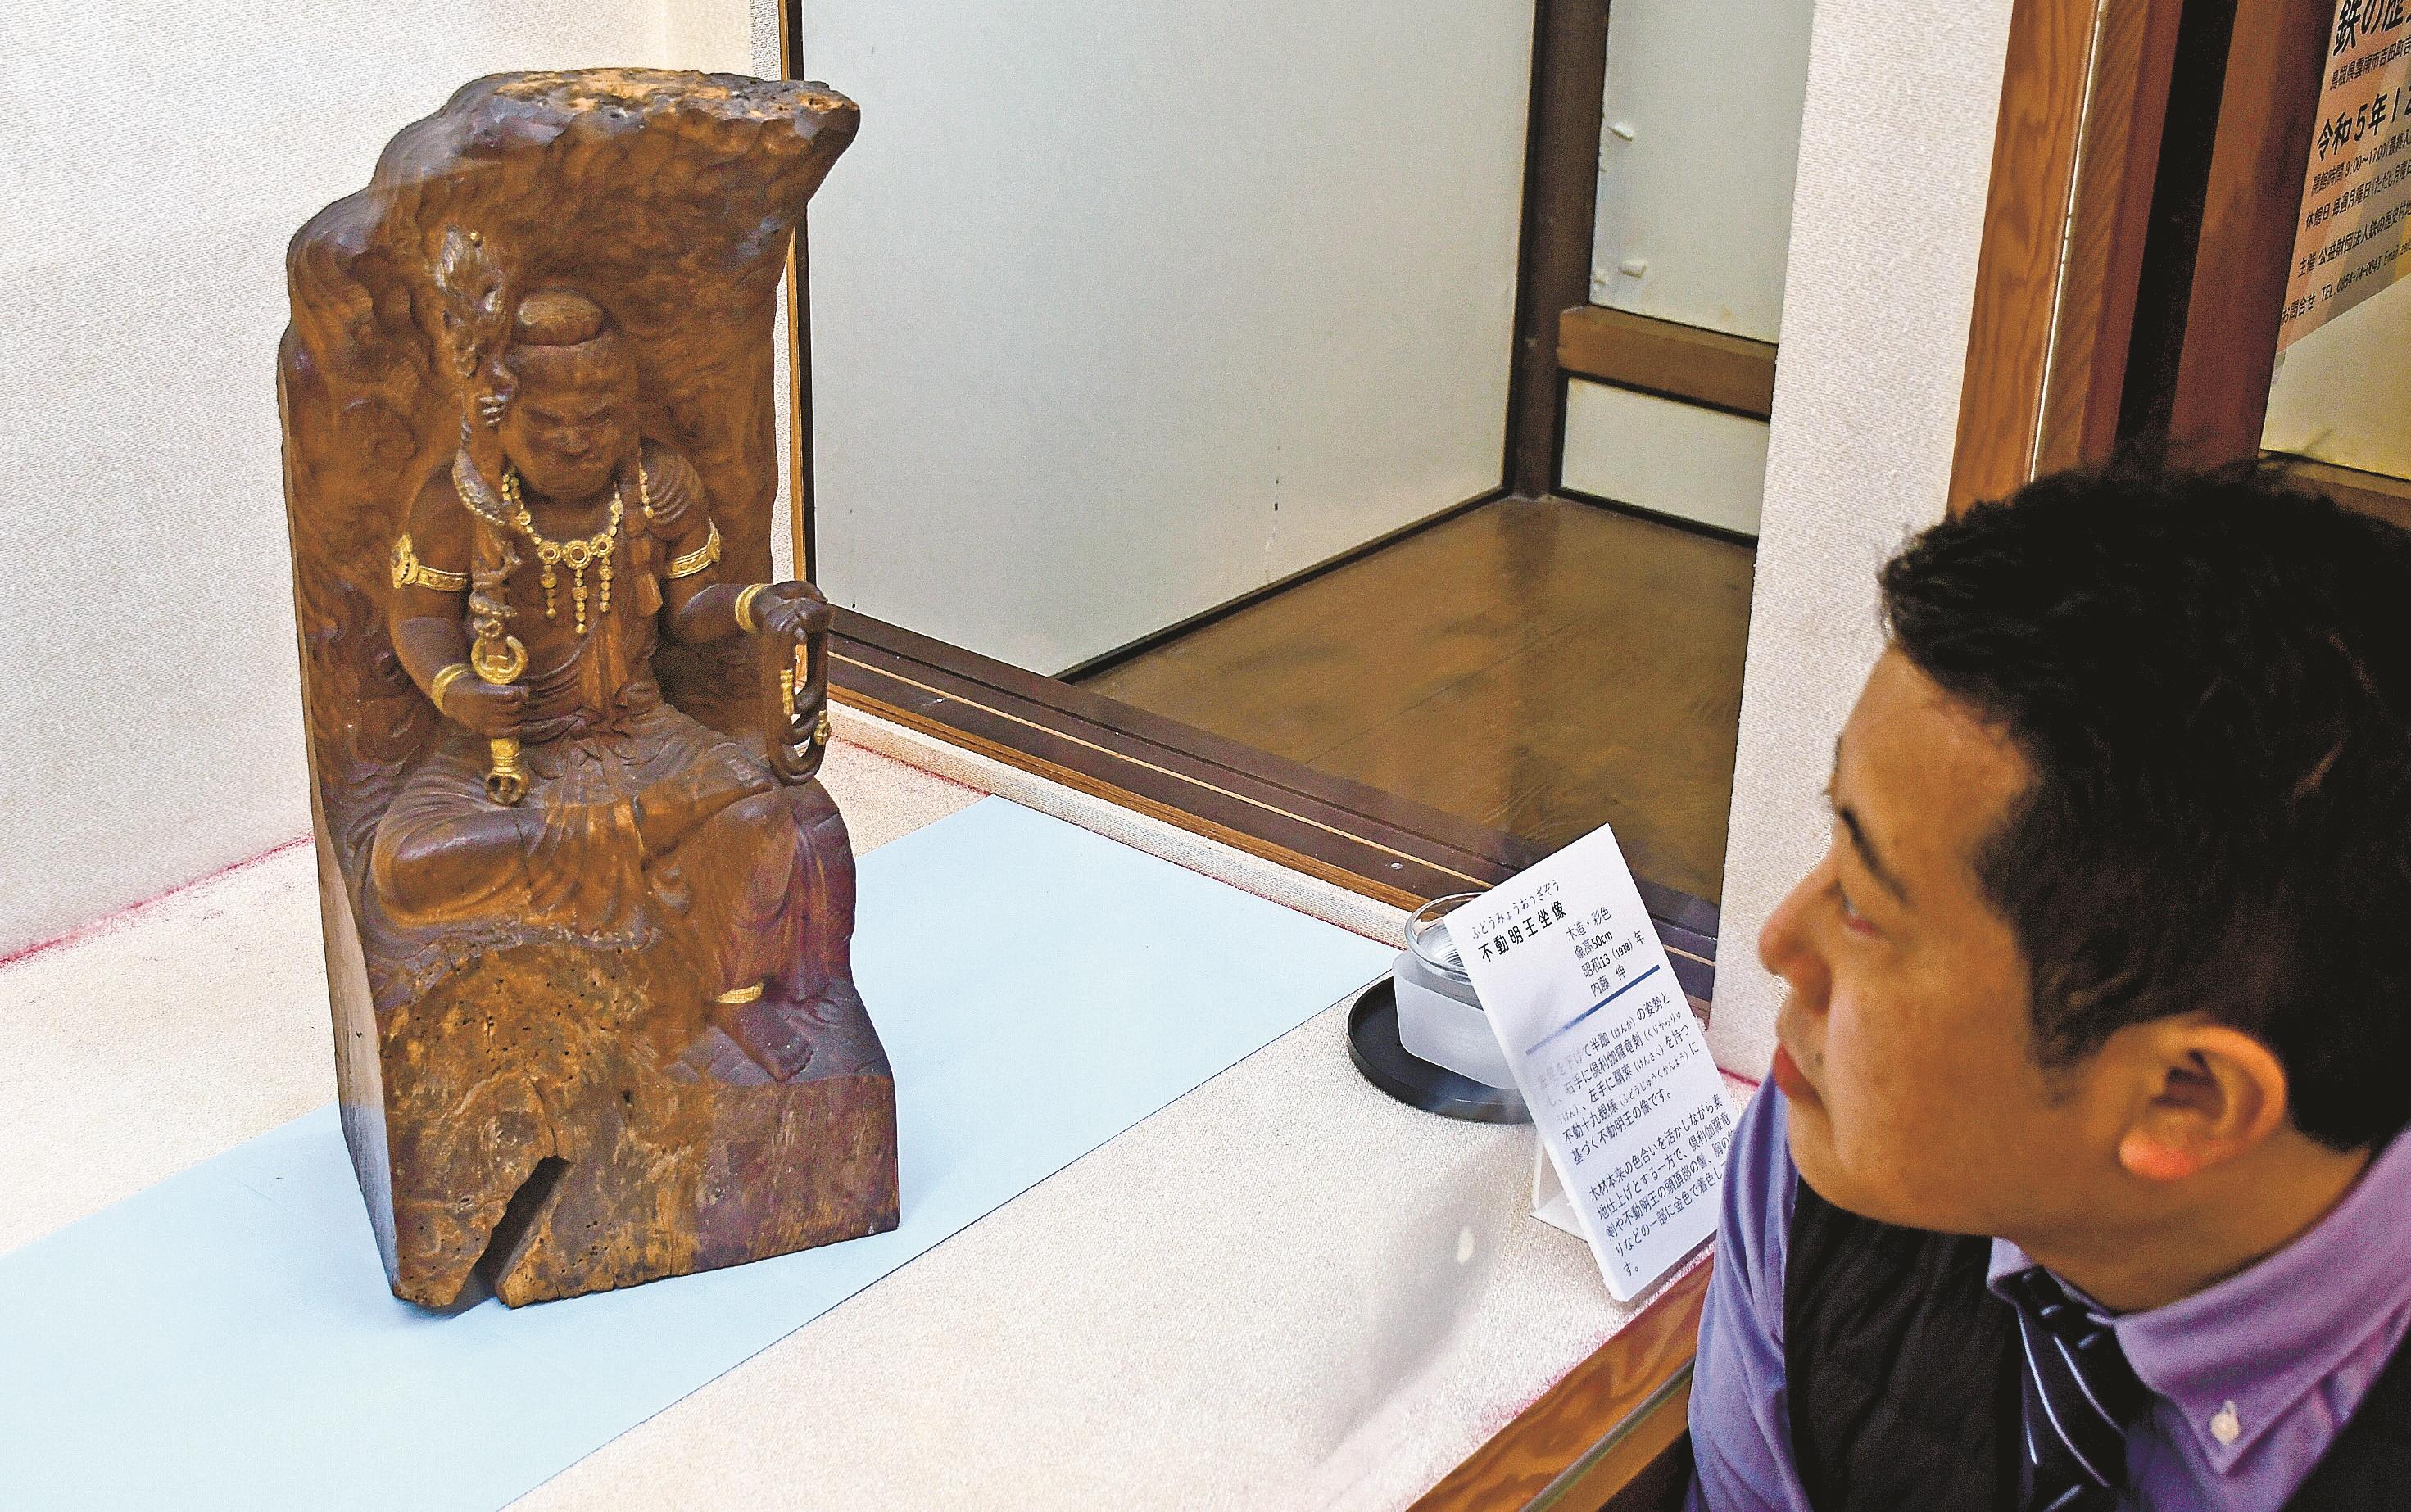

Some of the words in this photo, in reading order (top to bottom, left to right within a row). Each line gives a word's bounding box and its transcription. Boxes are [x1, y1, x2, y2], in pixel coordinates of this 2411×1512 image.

[2332, 0, 2411, 57] 鉄の歴
[1472, 880, 1560, 939] ふどうみょうおうざぞう
[1478, 901, 1566, 962] 不動明王坐像
[1566, 906, 1611, 942] 木造・彩色
[1573, 930, 1613, 961] 像高50cm
[1622, 1261, 1639, 1277] す。
